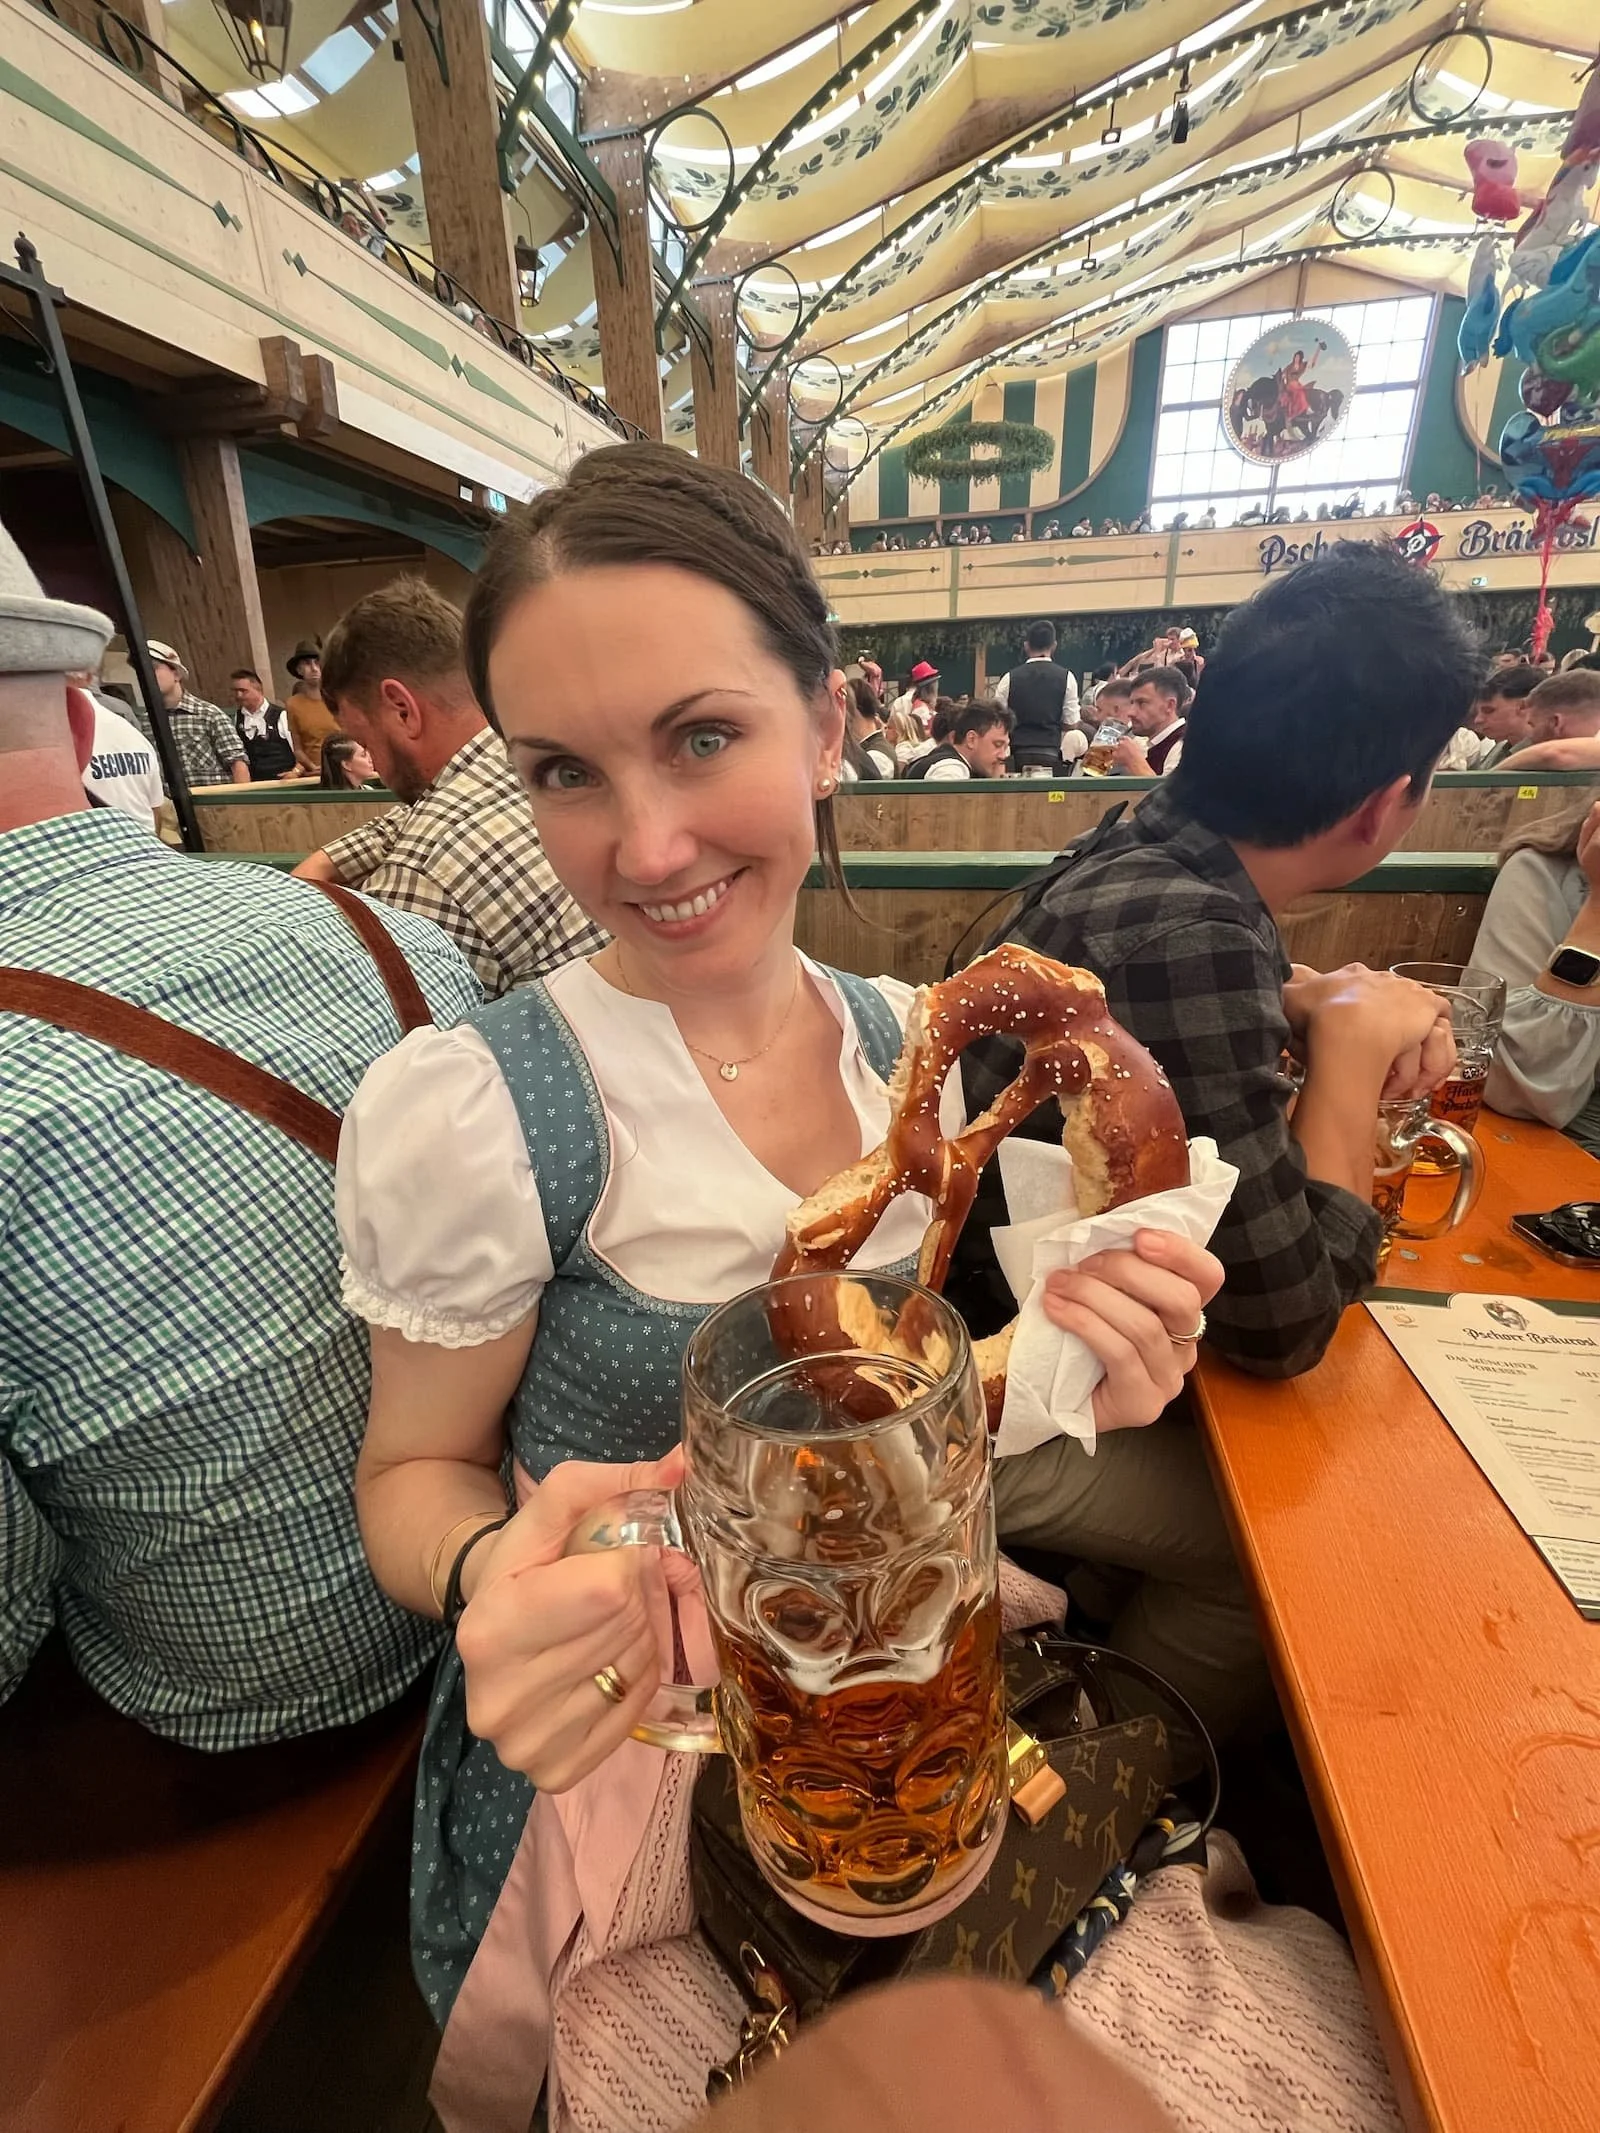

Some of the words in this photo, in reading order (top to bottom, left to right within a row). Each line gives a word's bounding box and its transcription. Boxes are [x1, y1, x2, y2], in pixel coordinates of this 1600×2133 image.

[90, 752, 151, 780] SECURITY
[1462, 1327, 1524, 1342] Pschorr
[1526, 1332, 1599, 1347] Bräurosl
